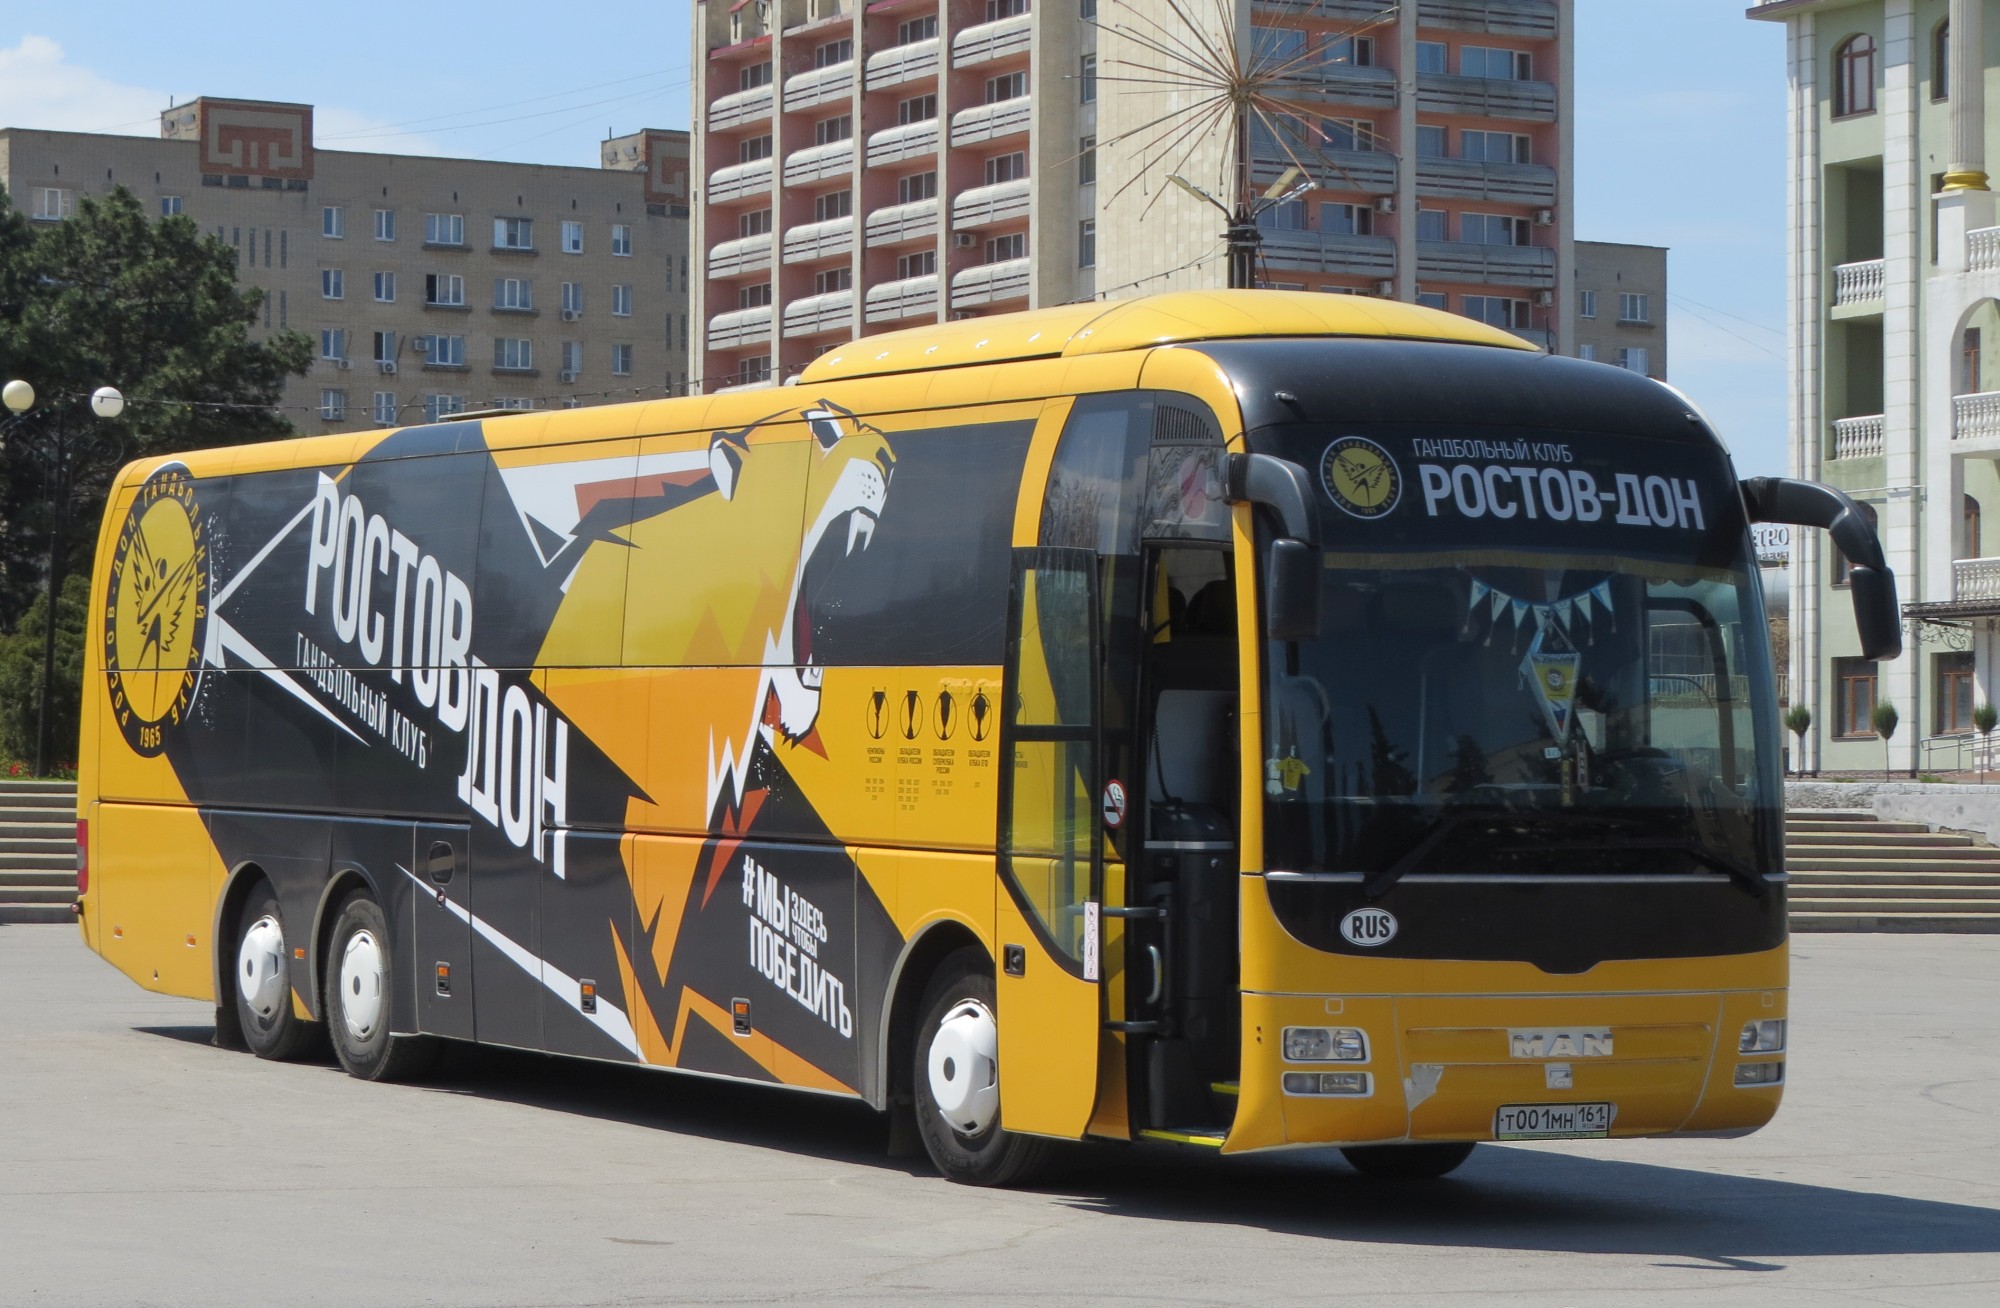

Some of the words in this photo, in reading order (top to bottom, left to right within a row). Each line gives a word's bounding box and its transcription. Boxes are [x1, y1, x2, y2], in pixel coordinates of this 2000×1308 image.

[1412, 438, 1531, 461] ГАНДБОЛЬНЫЙ
[1532, 443, 1573, 463] КЛУБ
[1419, 464, 1705, 530] РОСТОВ-ДОН
[143, 471, 206, 618] ГАНДБОЛЬНЫЙ
[107, 512, 136, 728] РОСТОВ-ДОН
[171, 646, 198, 726] КЛУБ
[296, 631, 387, 738] ГАНДБОЛЬНЫЙ
[392, 708, 426, 769] КЛУБ
[305, 471, 473, 732] РОСТОВ
[458, 654, 568, 880] ДОН
[140, 726, 161, 748] 1965
[742, 855, 790, 938] #МЫ
[791, 891, 828, 943] ЗДЕСЬ
[1352, 915, 1390, 938] RUS
[792, 922, 817, 959] ЧТОБЫ
[750, 915, 852, 1039] ПОБЕДИТЬ
[1511, 1033, 1613, 1057] MAN
[1578, 1106, 1603, 1122] 161
